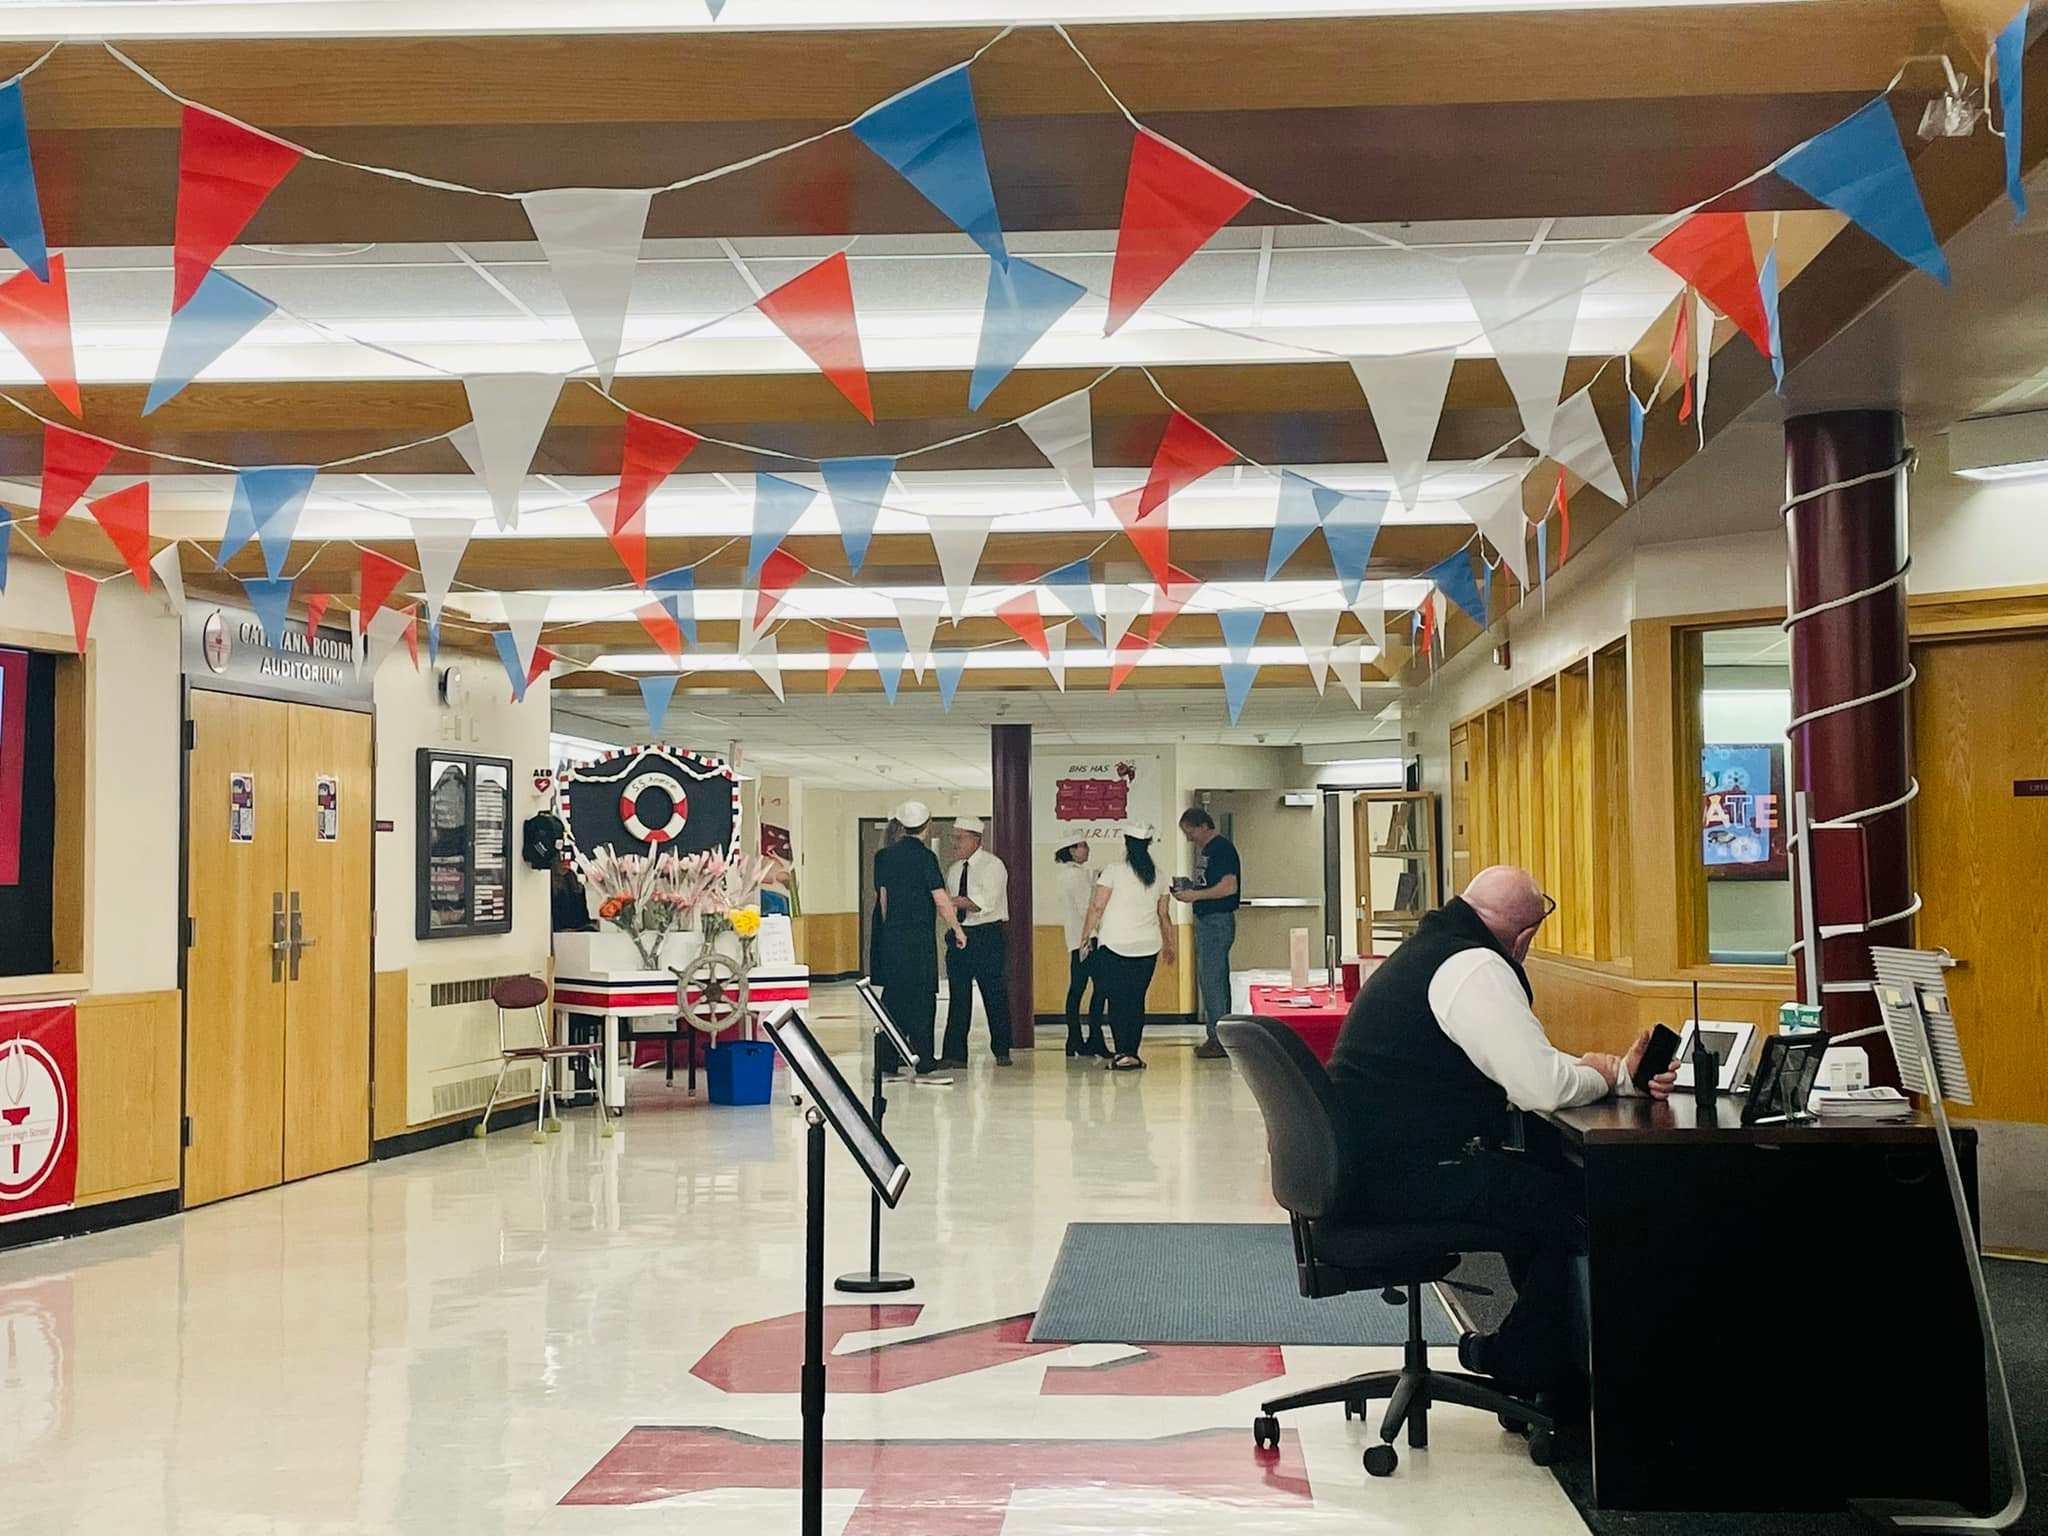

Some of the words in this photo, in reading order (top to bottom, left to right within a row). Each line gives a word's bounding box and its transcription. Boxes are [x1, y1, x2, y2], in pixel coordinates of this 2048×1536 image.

[313, 636, 355, 663] RODIN
[261, 655, 344, 685] AUDITORIUM
[533, 769, 553, 777] AED
[1090, 764, 1110, 773] HAS
[1703, 795, 1778, 828] ATE
